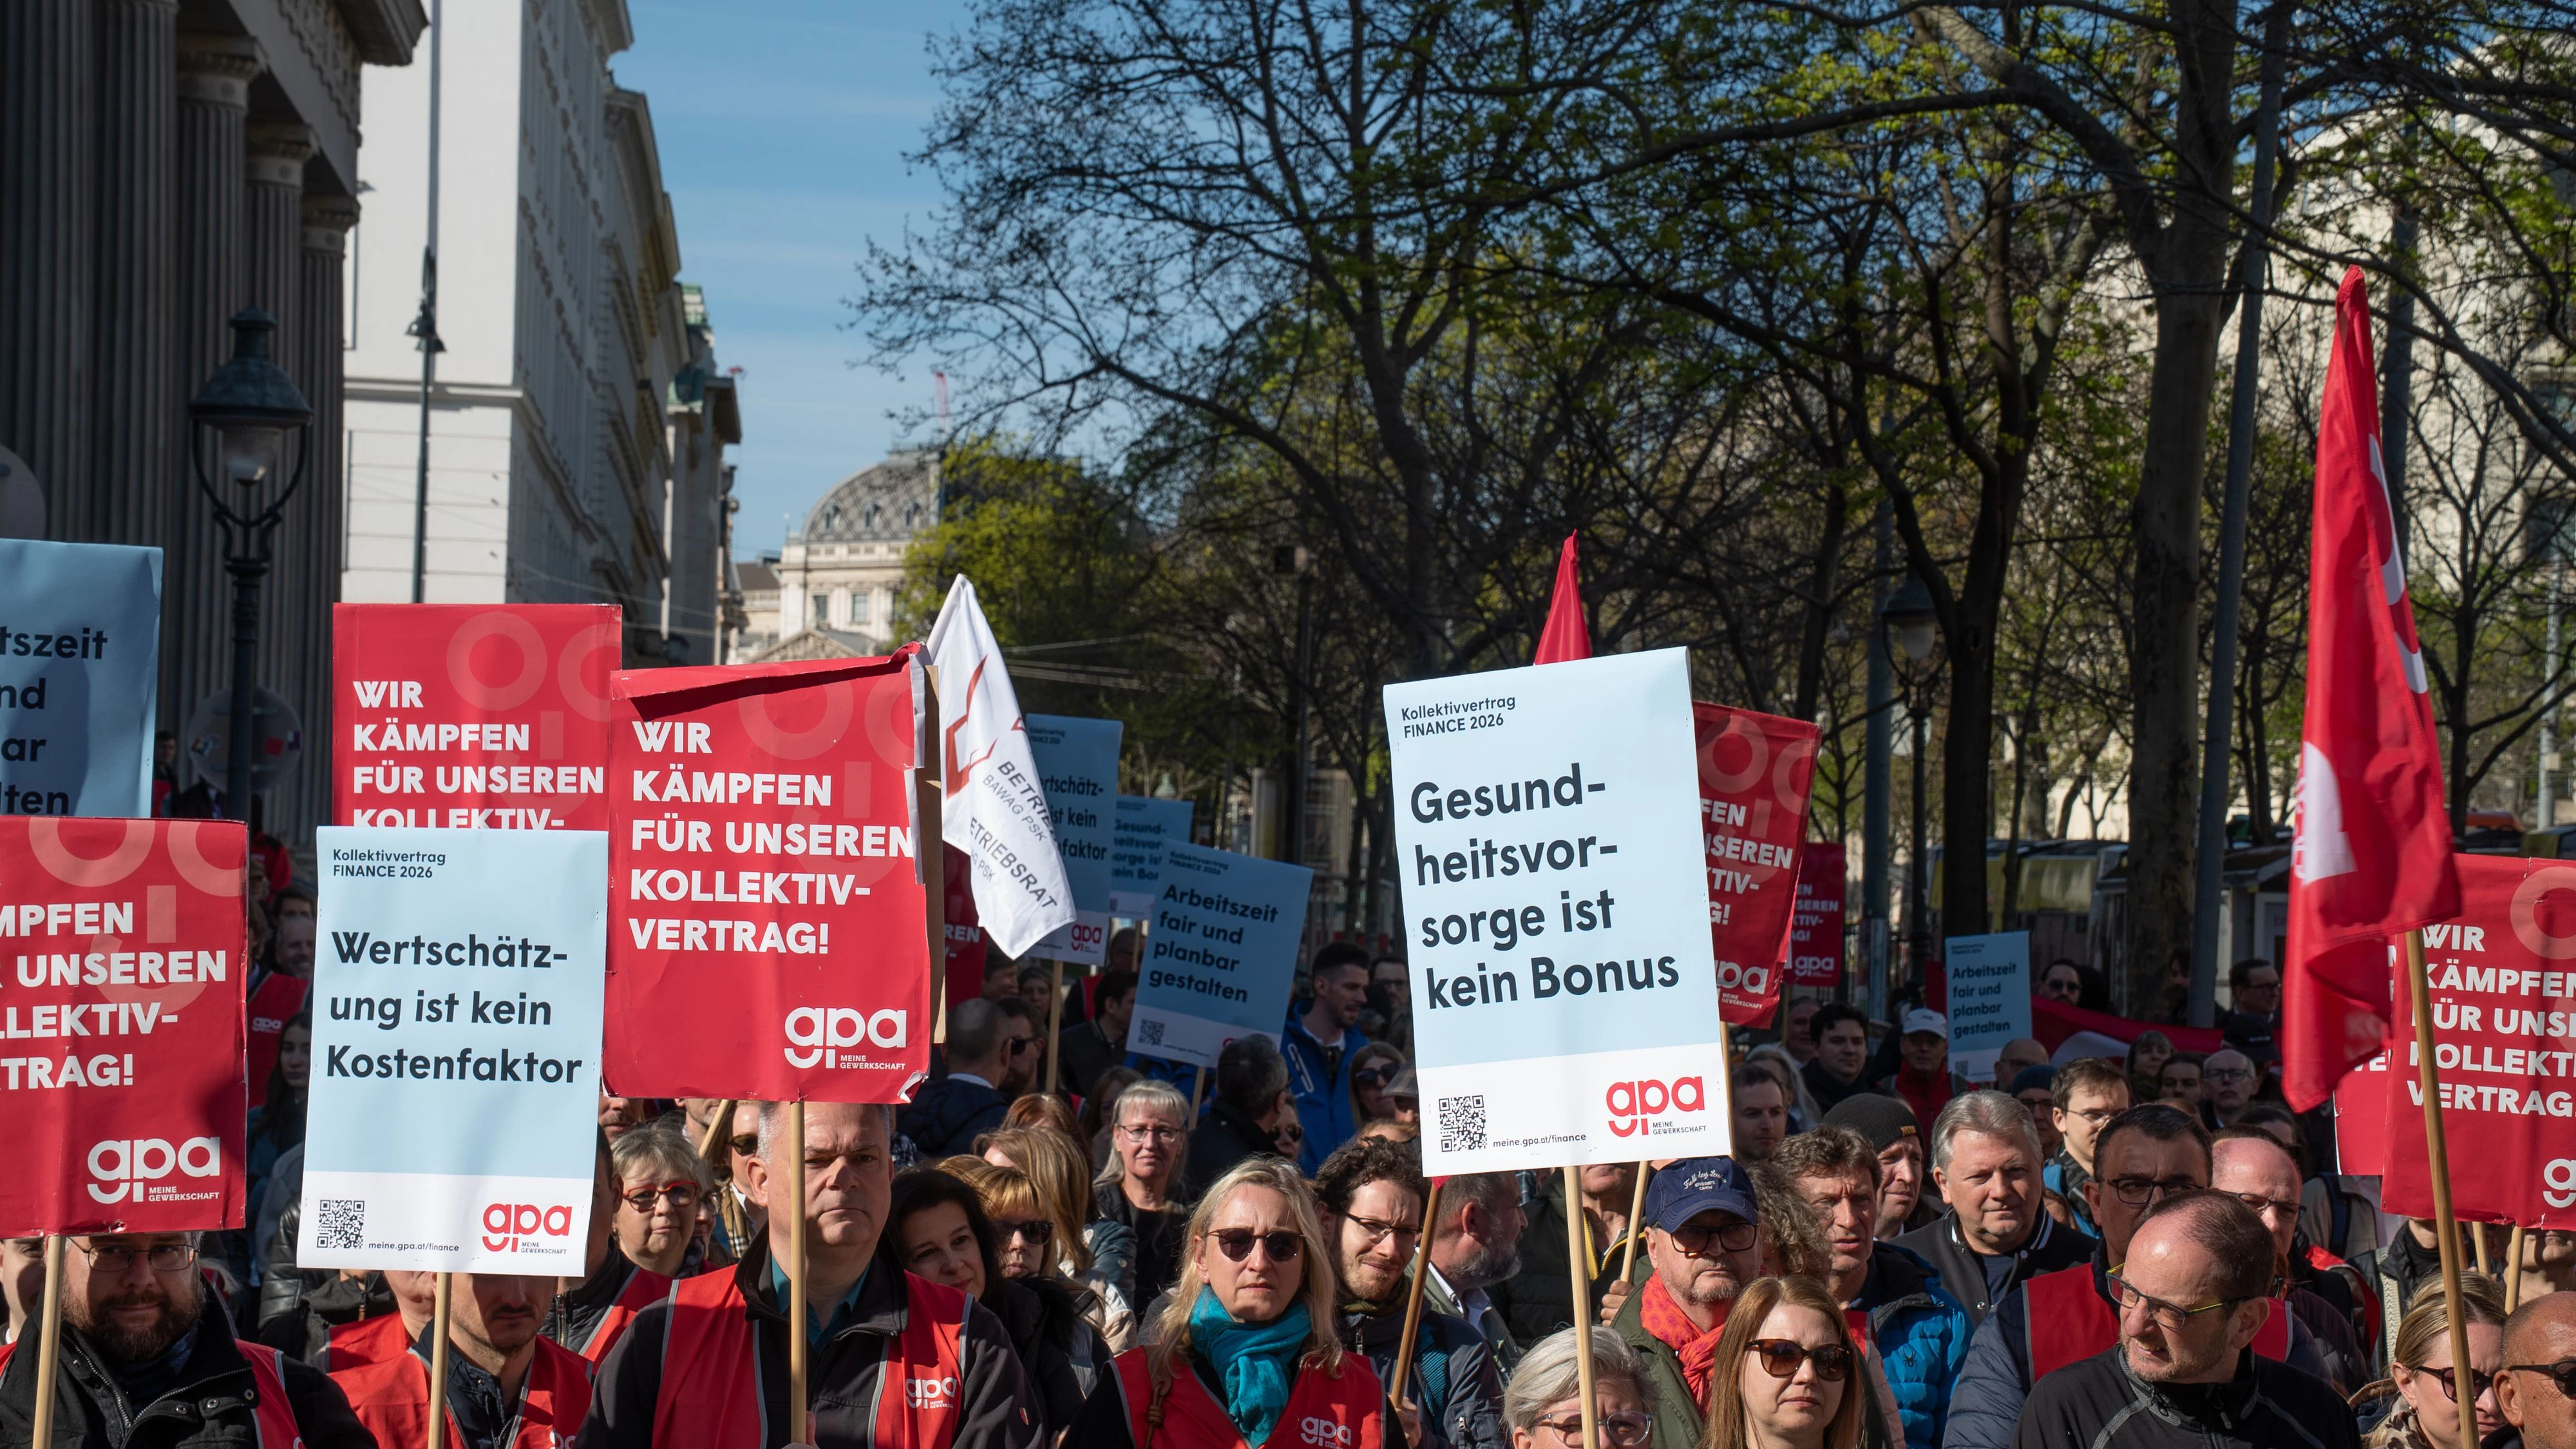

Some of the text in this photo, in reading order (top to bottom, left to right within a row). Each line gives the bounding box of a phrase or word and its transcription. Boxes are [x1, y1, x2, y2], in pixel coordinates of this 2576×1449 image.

[353, 681, 424, 708] WIR
[1401, 696, 1516, 721] Kollektivvertrag
[354, 717, 529, 752] KÄMPFEN
[632, 721, 712, 754] WIR
[1404, 713, 1504, 739] FINANCE 2026
[1, 737, 47, 762] ar
[354, 760, 604, 793] FÜR UNSEREN
[633, 764, 831, 806] KÄMPFEN
[1410, 762, 1605, 824] Gesund-
[354, 808, 564, 829] KOLLEKTIV-
[983, 775, 1048, 842] BAWAG PSK
[1068, 806, 1097, 828] kein
[632, 813, 914, 858] FÜR UNSEREN
[333, 849, 446, 866] Kollektivvertrag
[333, 865, 433, 878] FINANCE 2026
[978, 859, 997, 882] PSK
[1415, 835, 1618, 886] heitsvor-
[630, 869, 871, 905] KOLLEKTIV-
[1163, 884, 1278, 923] Arbeitszeit
[628, 917, 829, 954] VERTRAG!
[1159, 911, 1245, 945] fair und
[1421, 889, 1615, 951] sorge ist
[331, 931, 568, 969] Wertschätz-
[1071, 924, 1102, 951] gpa
[17, 950, 226, 987] UNSEREN
[1153, 940, 1240, 972] planbar
[1794, 955, 1835, 977] gpa
[1953, 962, 2016, 979] Arbeitszeit
[1148, 969, 1248, 1003] gestalten
[1426, 955, 1680, 1010] kein Bonus
[1714, 959, 1769, 1000] pa
[1953, 982, 2001, 998] fair und
[0, 1001, 178, 1039] LEKTIV-
[330, 989, 552, 1030] ung ist kein
[1953, 1002, 2002, 1020] planbar
[784, 1007, 907, 1069] gpa
[1954, 1020, 2011, 1039] gestalten
[327, 1045, 583, 1084] Kostenfaktor
[840, 1062, 905, 1070] GEWERKSCHAFT
[1606, 1076, 1705, 1137] gpa
[1492, 1132, 1587, 1148] meine.gpa.at/finance
[1653, 1125, 1707, 1135] GEWERKSCHAFT
[87, 1137, 220, 1204] gpa
[148, 1191, 220, 1202] GEWERKSCHAFT
[482, 1203, 573, 1253] gpa
[368, 1241, 460, 1253] meine.gpa.at/finance
[905, 1377, 957, 1409] gpa
[1300, 1416, 1351, 1446] gpa
